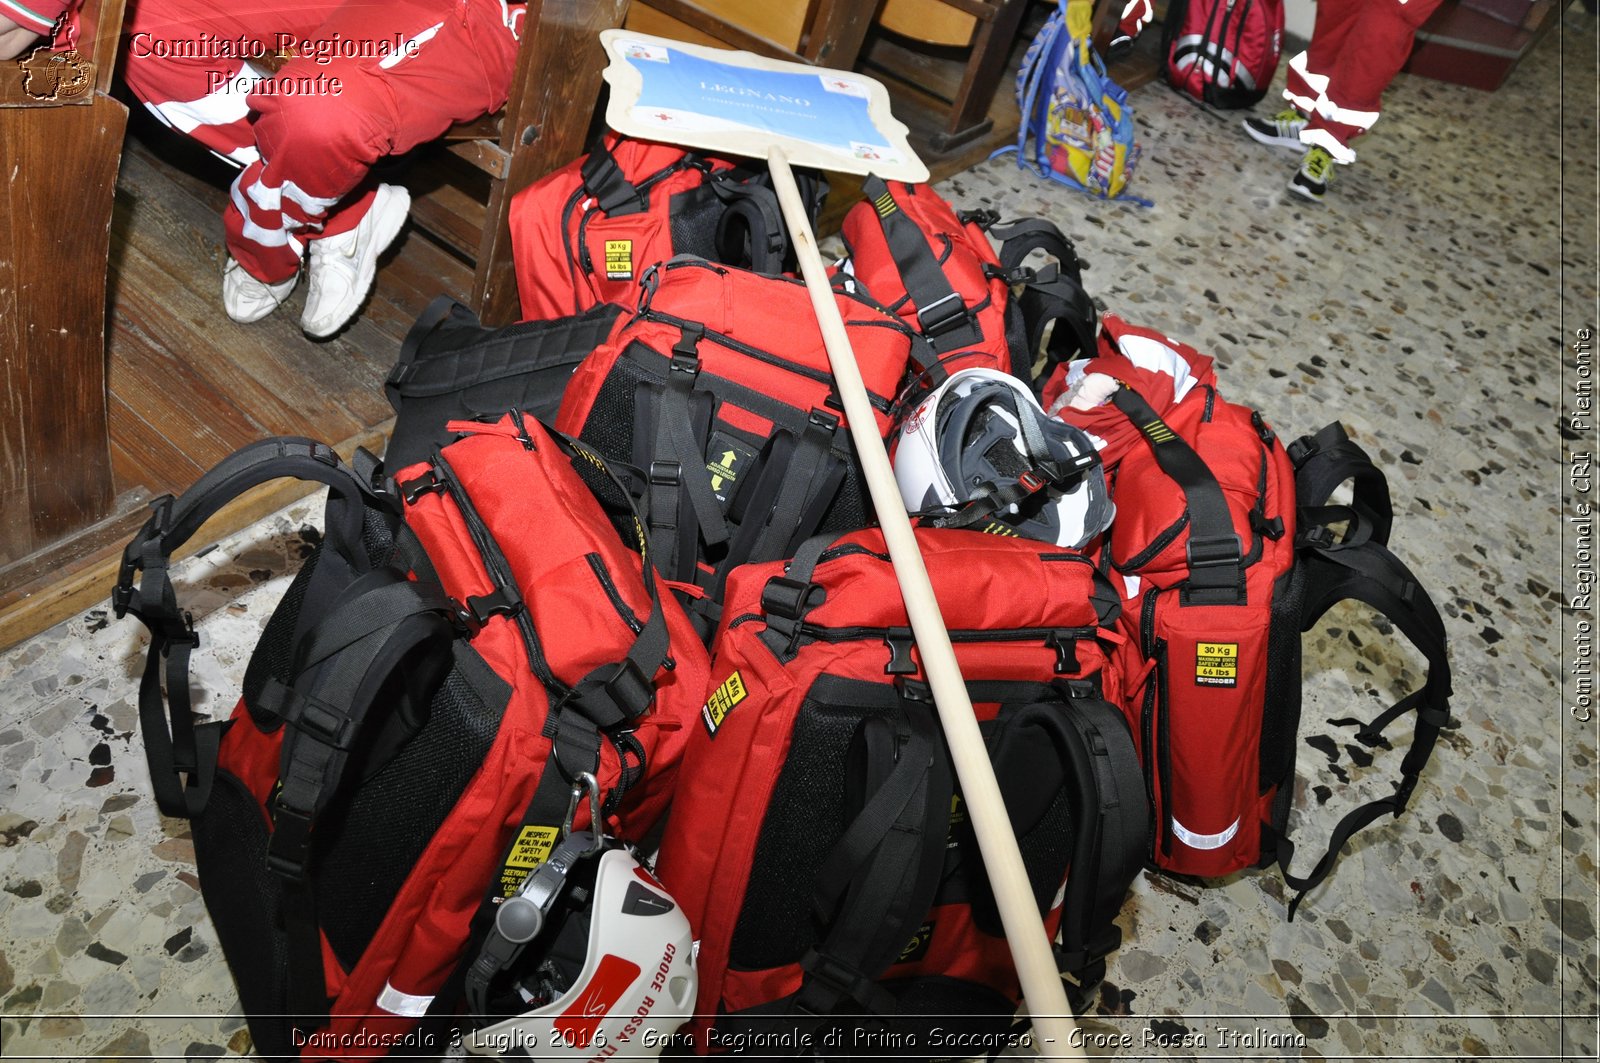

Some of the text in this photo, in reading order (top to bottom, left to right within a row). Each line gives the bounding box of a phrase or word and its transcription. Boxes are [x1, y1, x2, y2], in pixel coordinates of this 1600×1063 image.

[700, 81, 811, 107] LEGNANO
[1204, 646, 1230, 656] 30 Kg
[1202, 668, 1230, 676] 66 lbs
[525, 830, 551, 839] RESPECT
[517, 839, 552, 848] HEALTH AND
[519, 847, 543, 855] SAFETY
[522, 856, 541, 864] WORK
[650, 942, 676, 993] CROCE
[616, 995, 655, 1042] ROSSA
